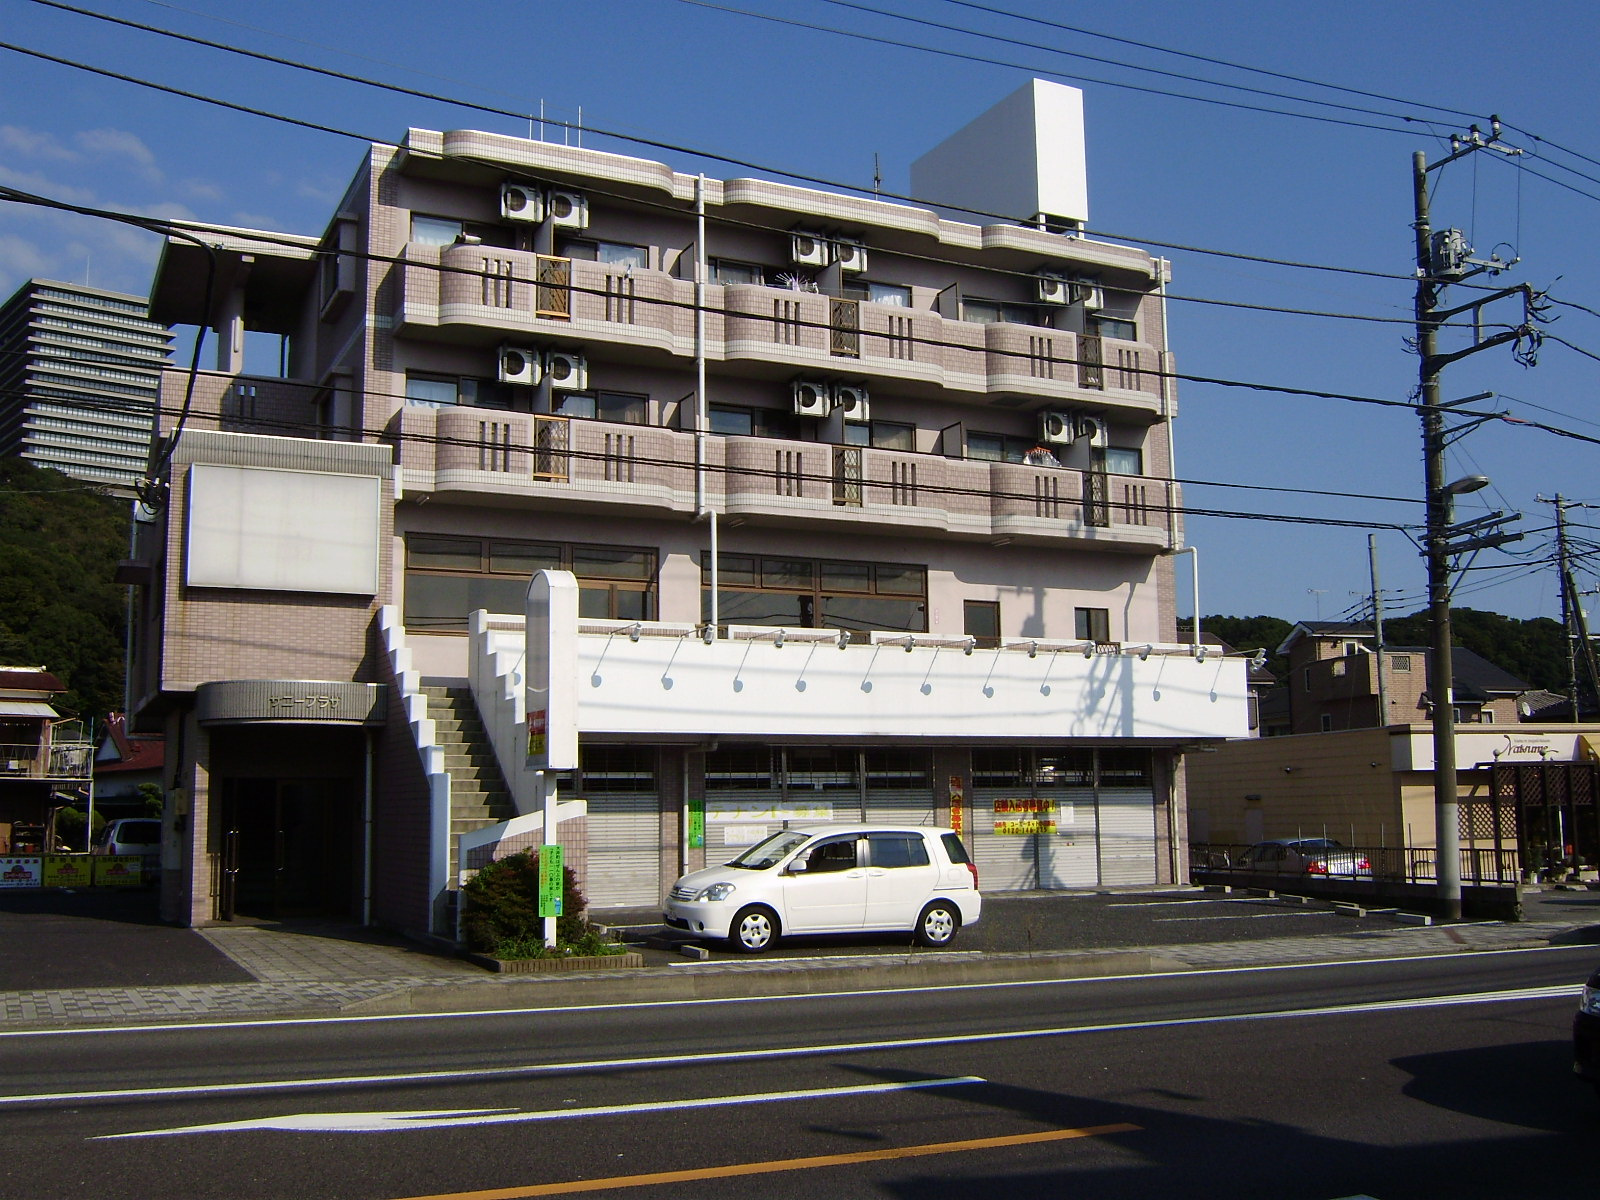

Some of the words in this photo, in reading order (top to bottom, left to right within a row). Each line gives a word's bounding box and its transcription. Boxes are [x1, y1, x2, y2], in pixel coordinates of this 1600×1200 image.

[268, 695, 342, 711] サニープラザ
[710, 805, 829, 819] テナント募集
